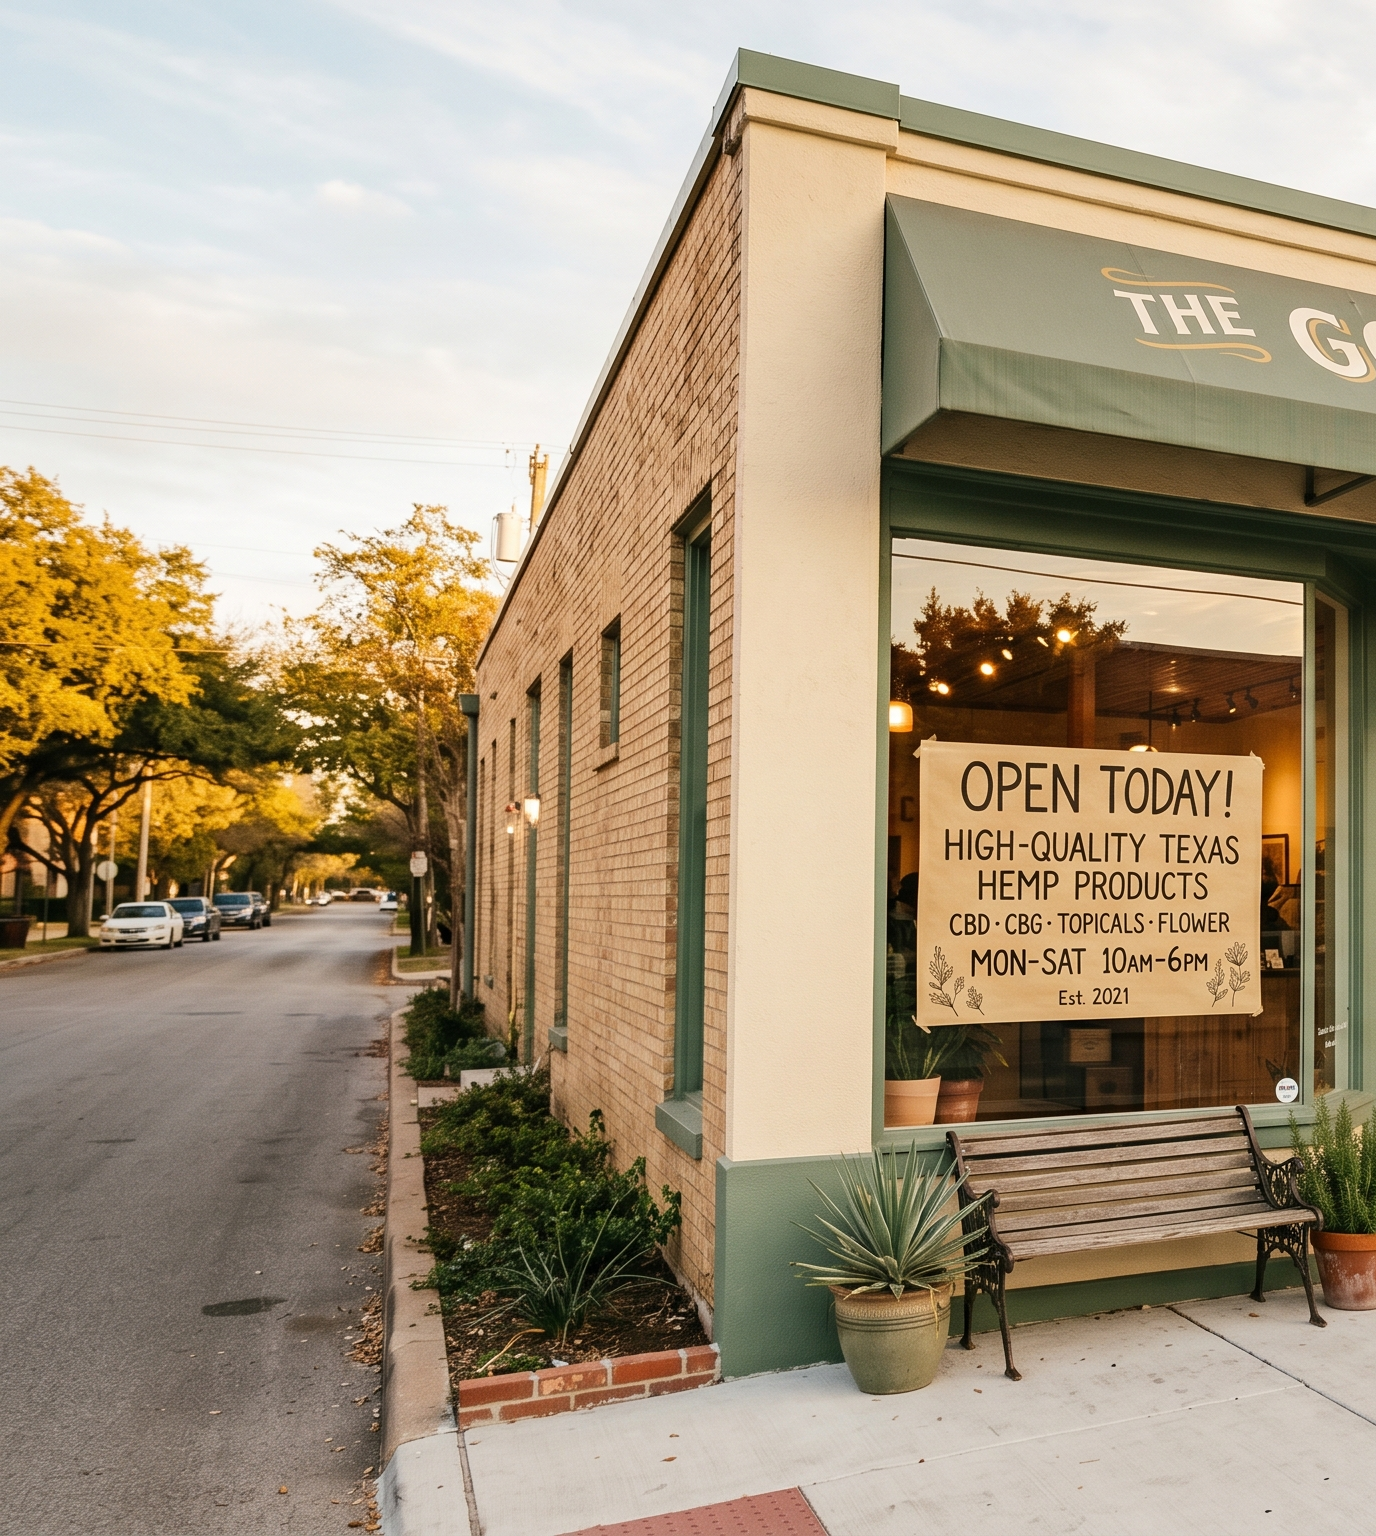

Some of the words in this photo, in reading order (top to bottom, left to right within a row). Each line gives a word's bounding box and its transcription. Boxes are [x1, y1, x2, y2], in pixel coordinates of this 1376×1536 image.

[1114, 289, 1257, 337] THE
[961, 761, 1080, 813] OPEN
[1100, 765, 1234, 818] TODAY!
[944, 828, 1146, 863] HIGH-QUALITY
[1160, 833, 1240, 865] TEXAS
[978, 870, 1059, 900] HEMP
[1075, 871, 1208, 900] PRODUCTS
[970, 947, 1086, 977] MON-SAT
[1102, 945, 1208, 975] 10AM-6PM
[1058, 989, 1086, 1005] Est.
[1092, 987, 1129, 1005] 2021
